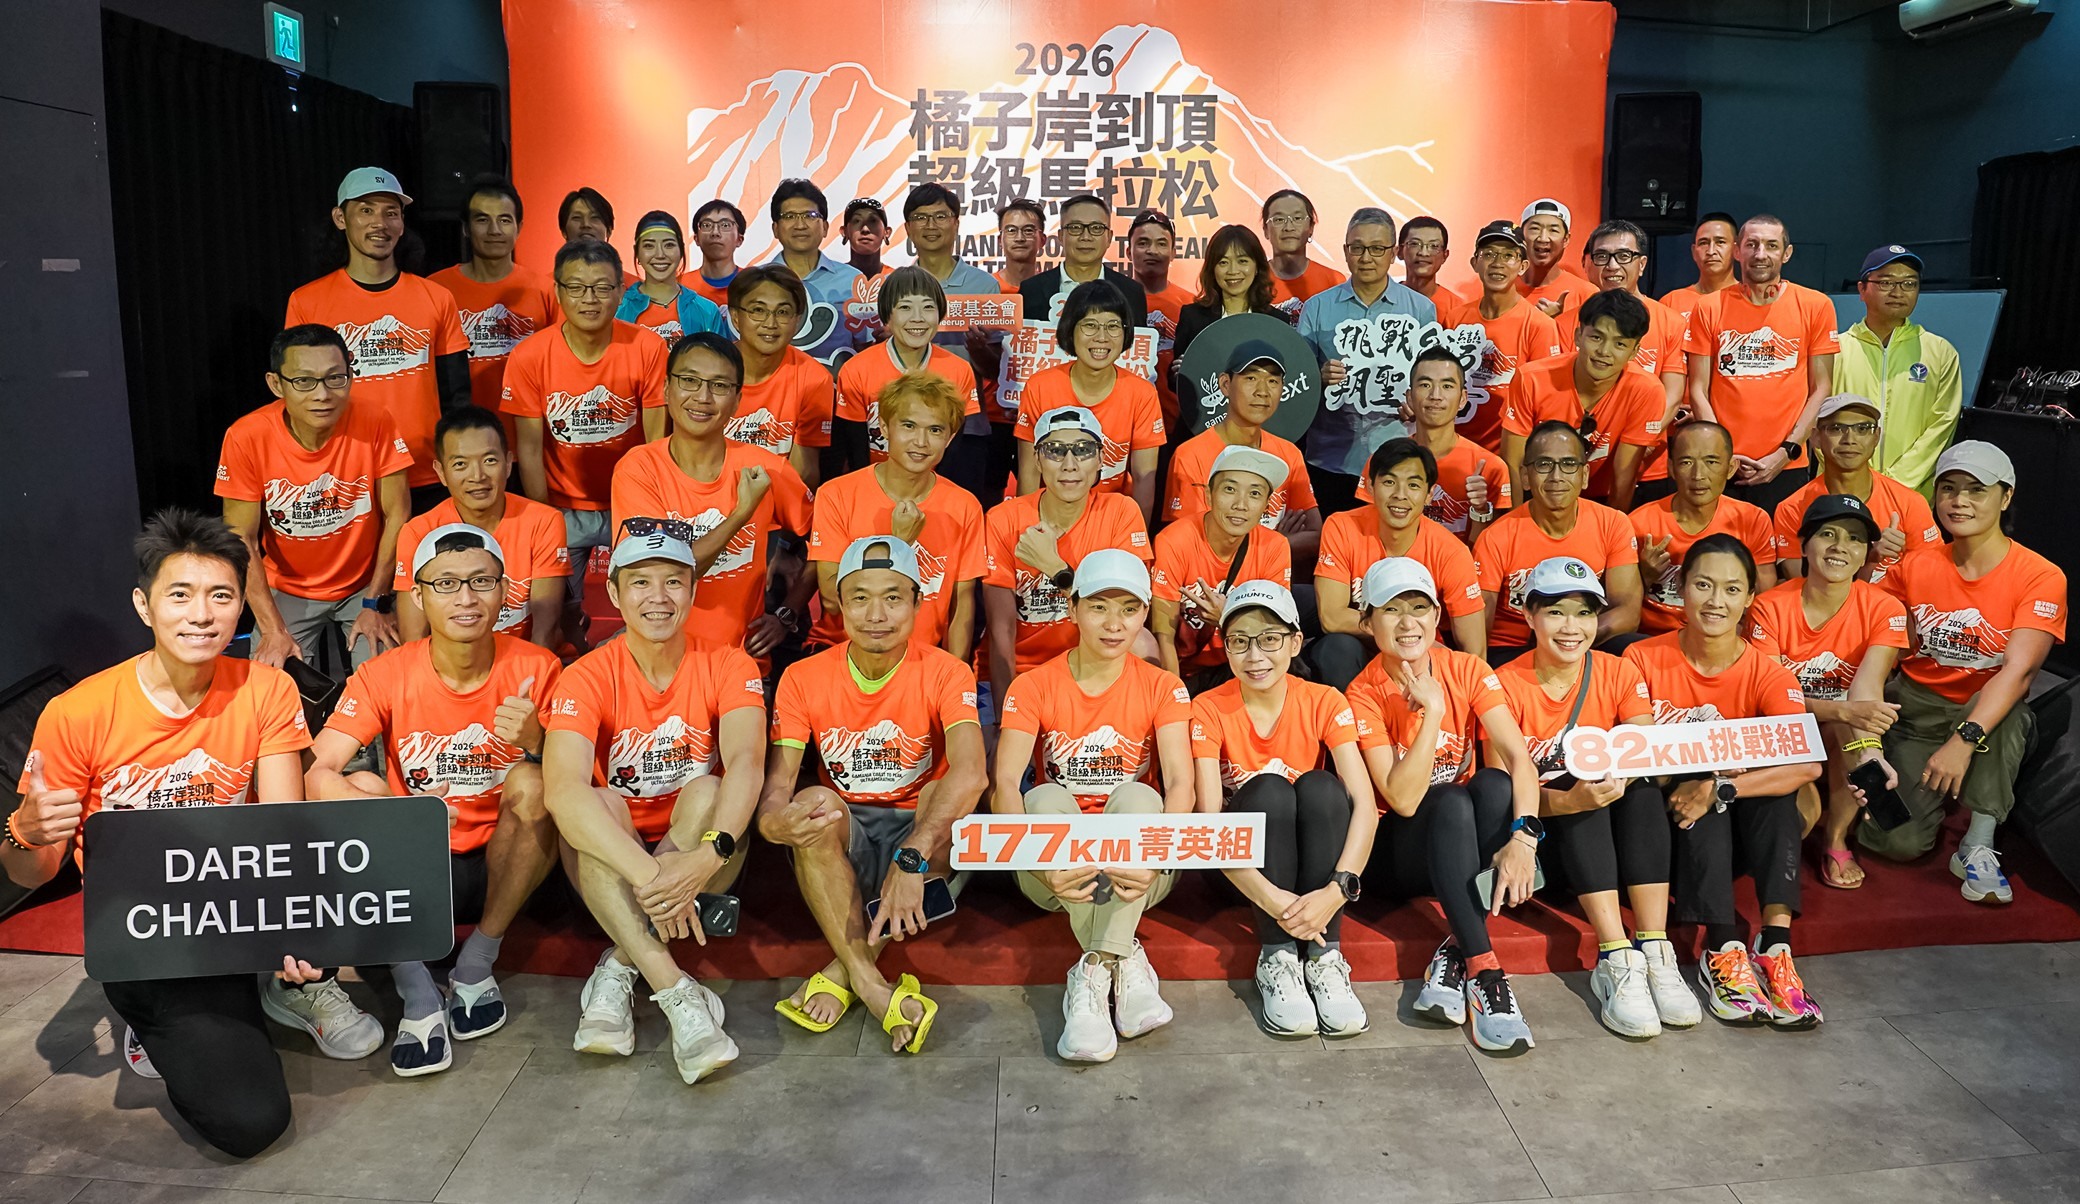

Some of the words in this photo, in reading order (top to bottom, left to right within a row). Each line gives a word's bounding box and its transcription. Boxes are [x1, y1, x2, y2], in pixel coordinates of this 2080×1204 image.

[1015, 42, 1114, 76] 2026
[908, 88, 1219, 154] 橘子岸到頂
[907, 155, 1220, 220] 超級馬拉松
[969, 317, 1016, 326] Foundation
[1010, 327, 1153, 362] 橘子頂
[1234, 592, 1274, 602] SUUNTO
[1947, 619, 1967, 629] 2026
[1806, 667, 1827, 675] 2026
[452, 742, 475, 751] 2026
[865, 737, 887, 746] 2026
[1084, 744, 1106, 753] 2026
[1570, 731, 1709, 772] 82KM
[1707, 722, 1812, 763] 挑戰組
[168, 771, 194, 784] 2026
[957, 822, 1132, 864] 177KM
[1137, 825, 1254, 862] 菁英組
[164, 842, 293, 883] DARE
[306, 838, 370, 876] TO
[125, 888, 413, 940] CHALLENGE
